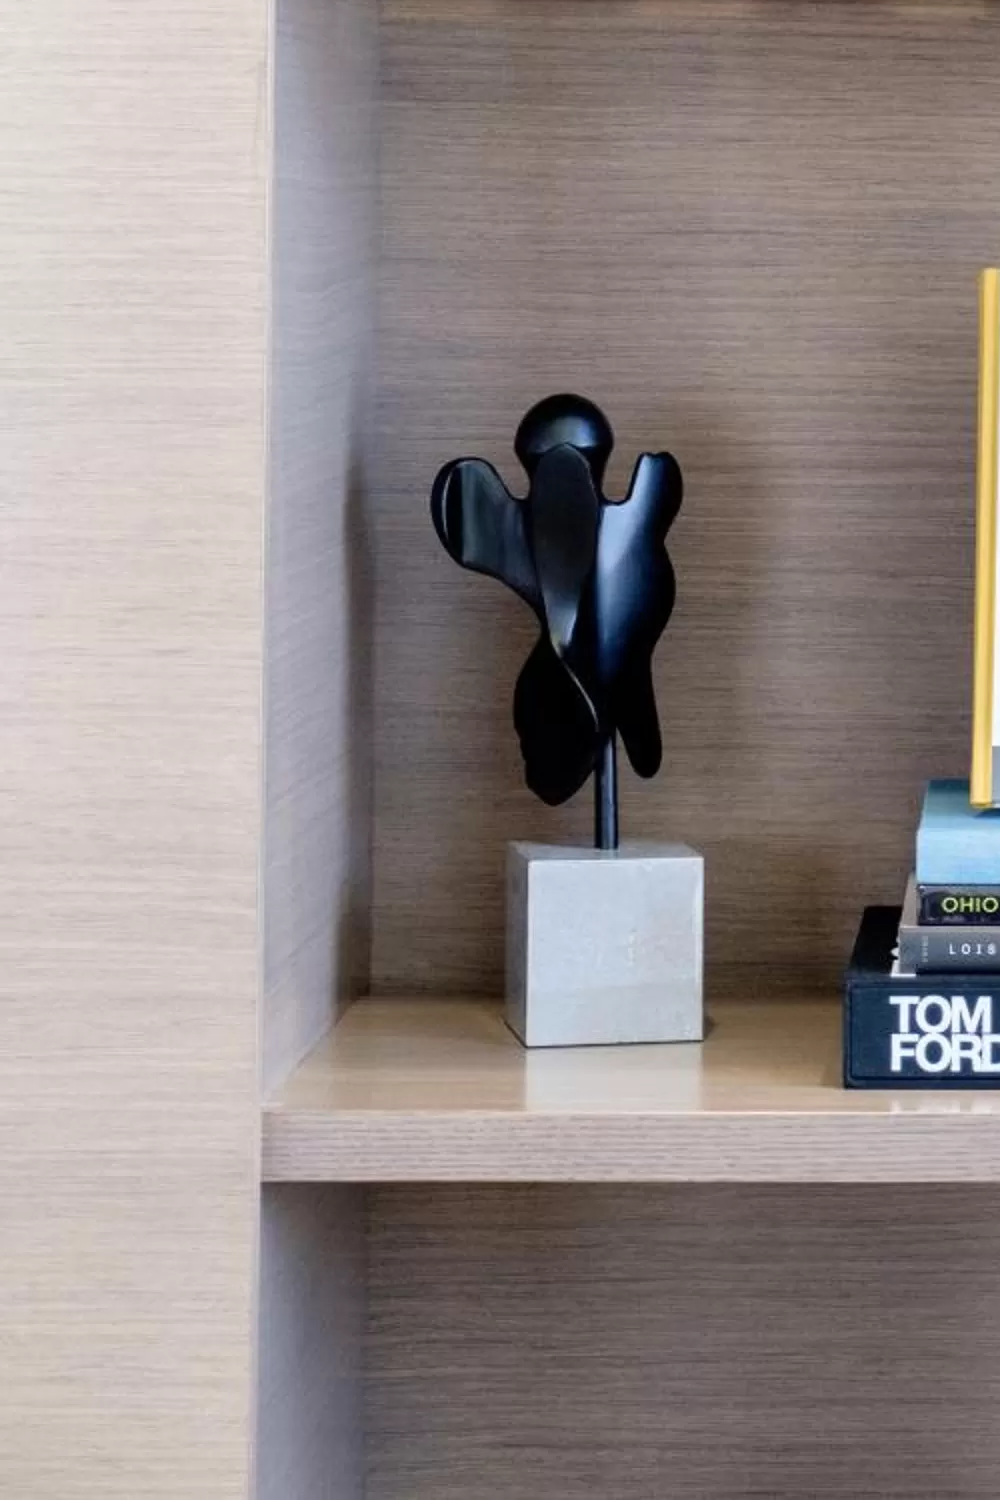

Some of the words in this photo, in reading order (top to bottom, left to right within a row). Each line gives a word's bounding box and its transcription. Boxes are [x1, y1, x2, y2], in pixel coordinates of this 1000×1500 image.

[941, 897, 999, 914] OHIO
[949, 942, 997, 955] LOIS
[889, 995, 992, 1034] TOM
